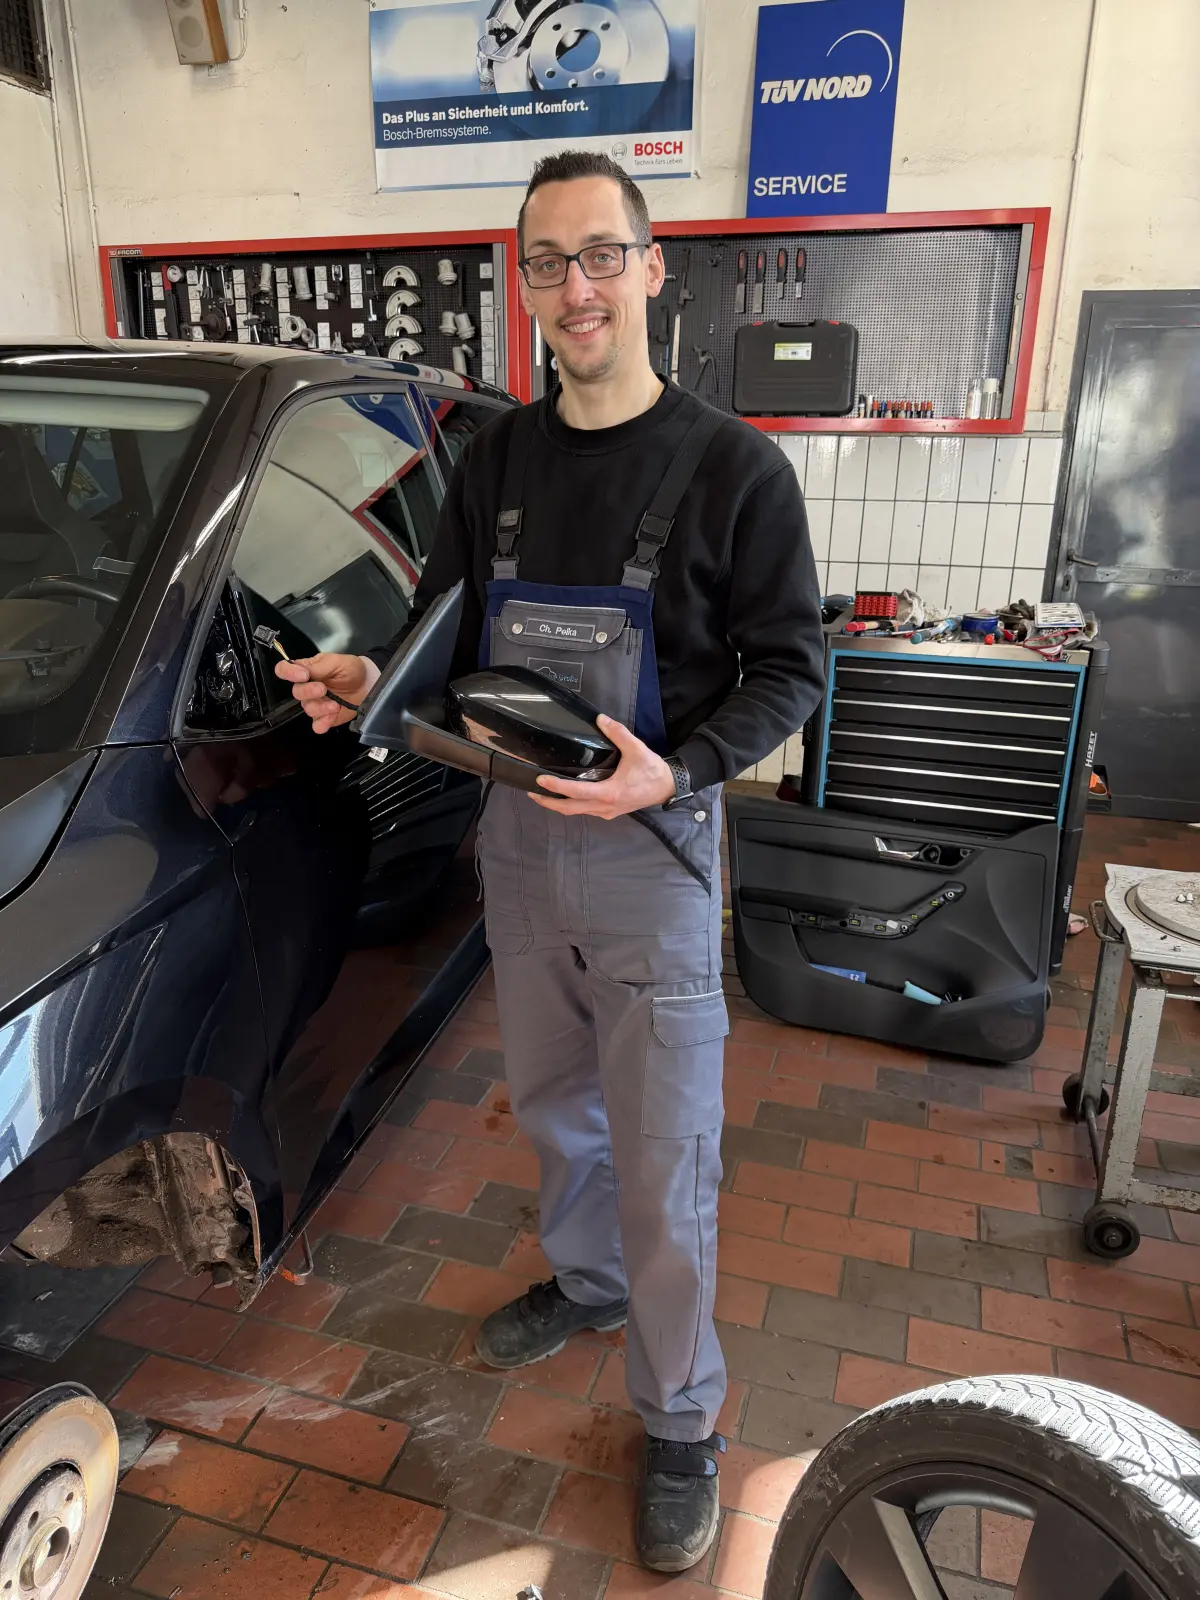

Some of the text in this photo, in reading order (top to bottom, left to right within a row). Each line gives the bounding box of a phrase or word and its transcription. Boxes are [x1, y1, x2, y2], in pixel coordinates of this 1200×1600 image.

[761, 75, 873, 104] TÜV NORD
[382, 99, 589, 124] Das Plus an Sicherheit und Komfort.
[383, 125, 492, 141] Bosch-Bremssysteme.
[634, 141, 683, 156] BOSCH
[753, 173, 848, 197] SERVICE
[540, 624, 552, 633] Ch.
[1085, 731, 1098, 768] HAZET
